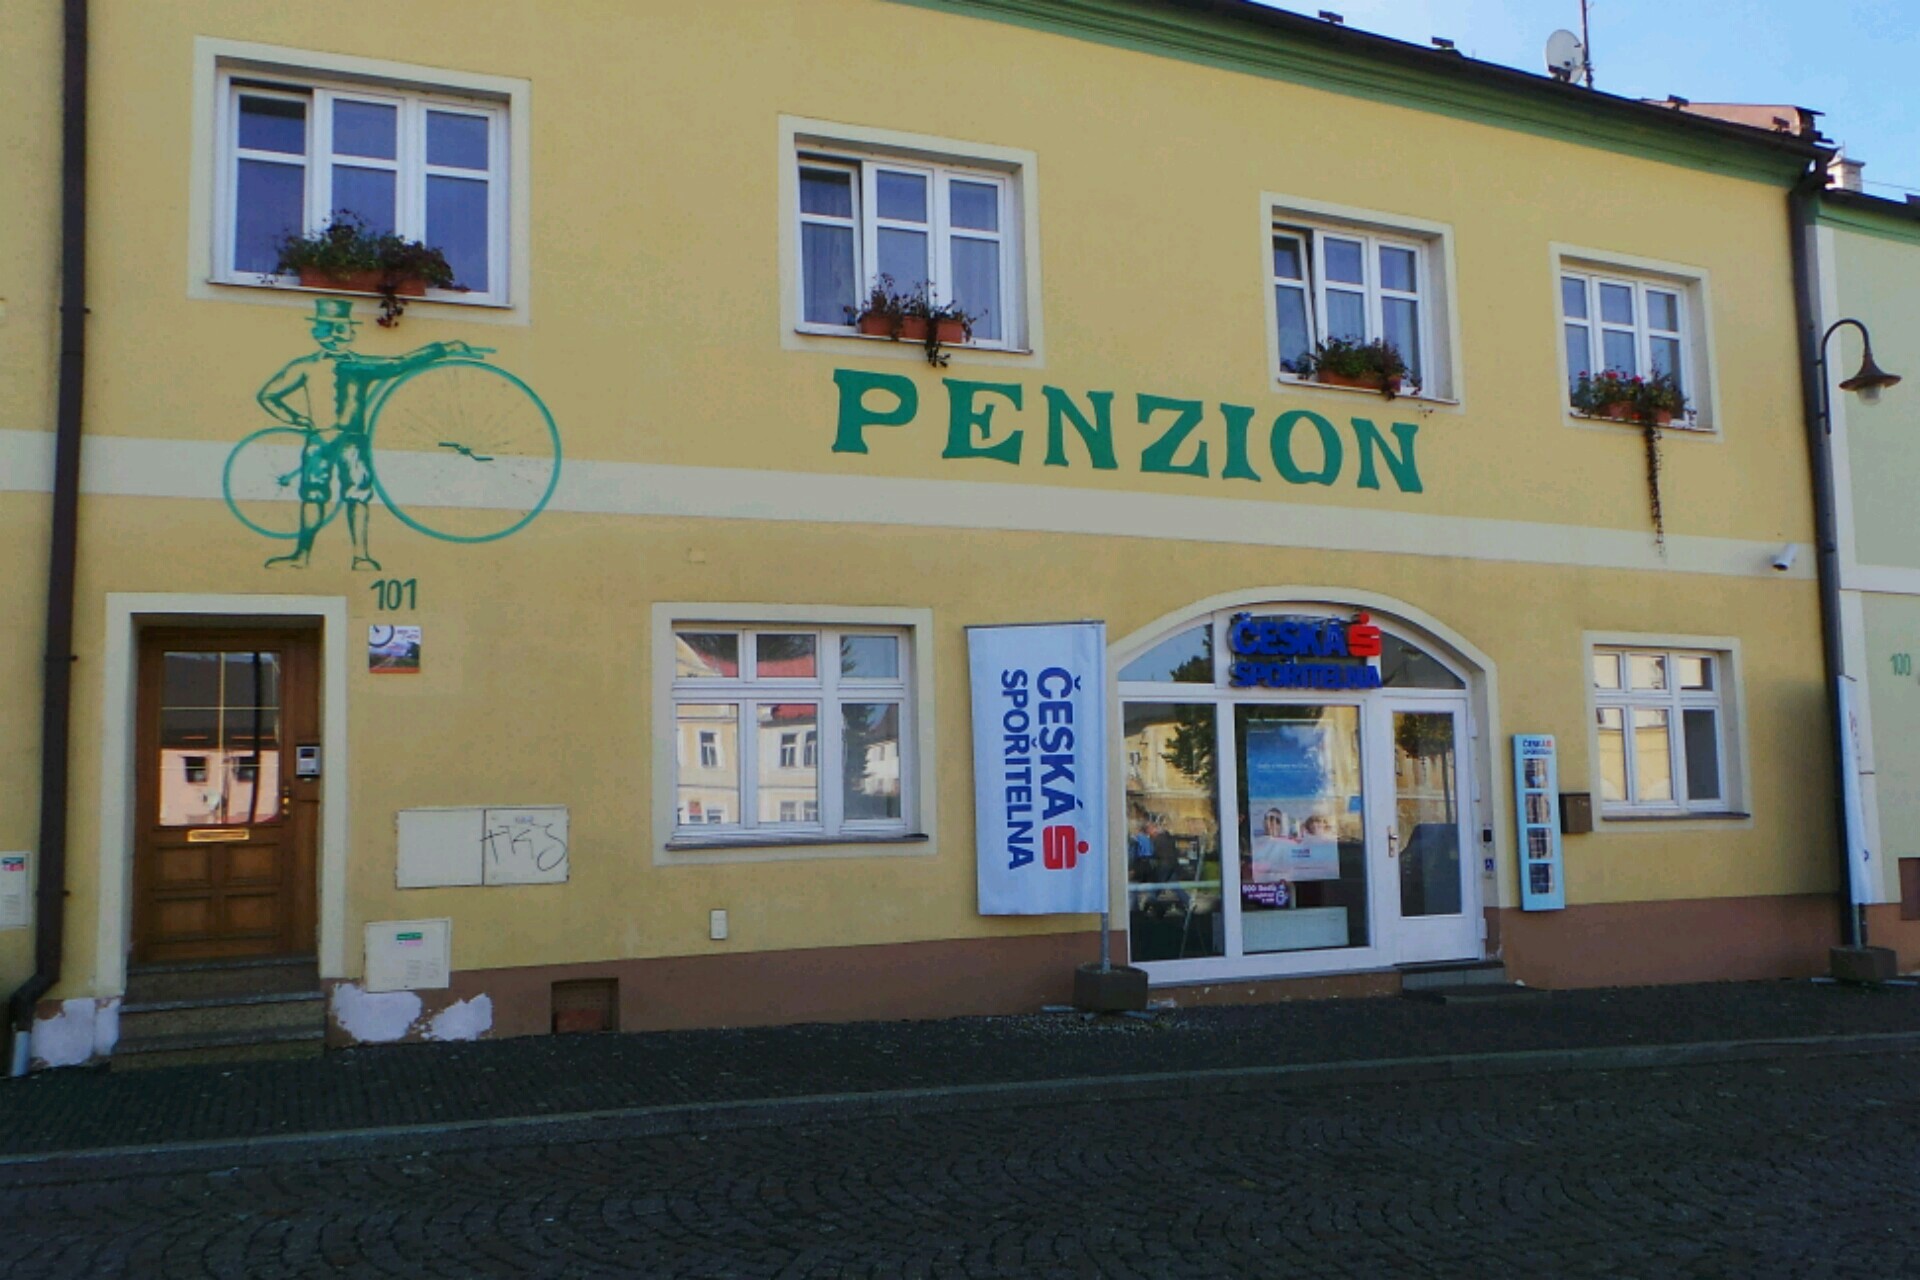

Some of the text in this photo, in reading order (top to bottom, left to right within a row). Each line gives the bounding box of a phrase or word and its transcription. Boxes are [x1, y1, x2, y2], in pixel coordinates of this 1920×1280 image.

[831, 368, 1423, 493] PENZION
[370, 578, 417, 611] 101
[1232, 612, 1348, 657] ČESKÁ
[1890, 653, 1911, 676] 100
[1001, 669, 1038, 870] SPOŘITELNA
[1036, 666, 1083, 821] ČESKÁ
